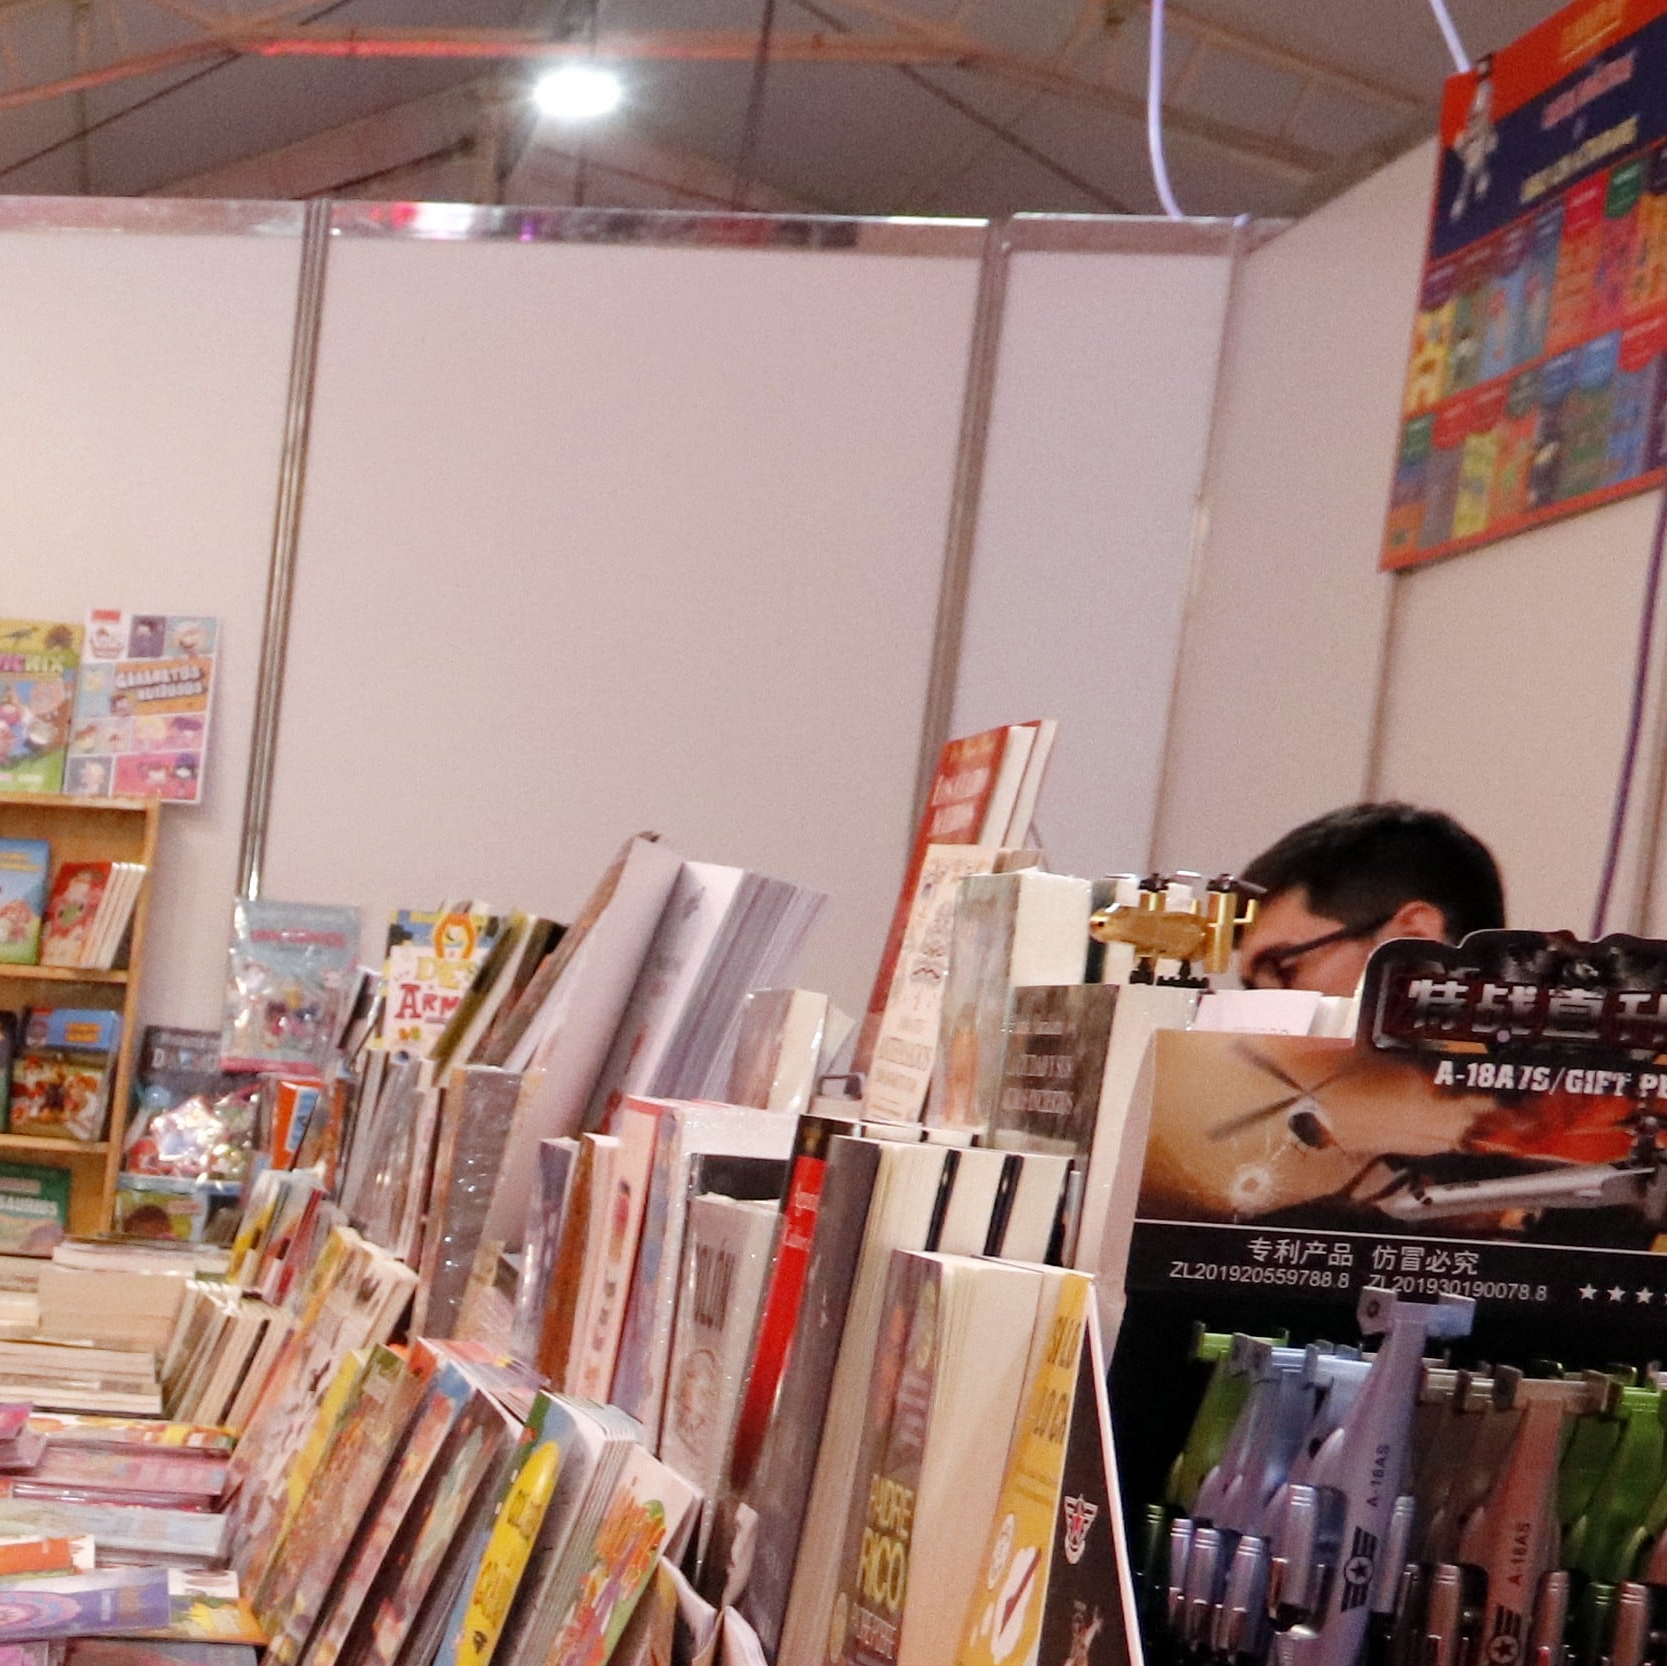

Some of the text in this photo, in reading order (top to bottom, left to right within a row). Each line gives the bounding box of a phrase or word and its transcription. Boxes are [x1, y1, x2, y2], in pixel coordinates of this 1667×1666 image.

[1248, 1237, 1480, 1275] 专利产品 仿冒必究
